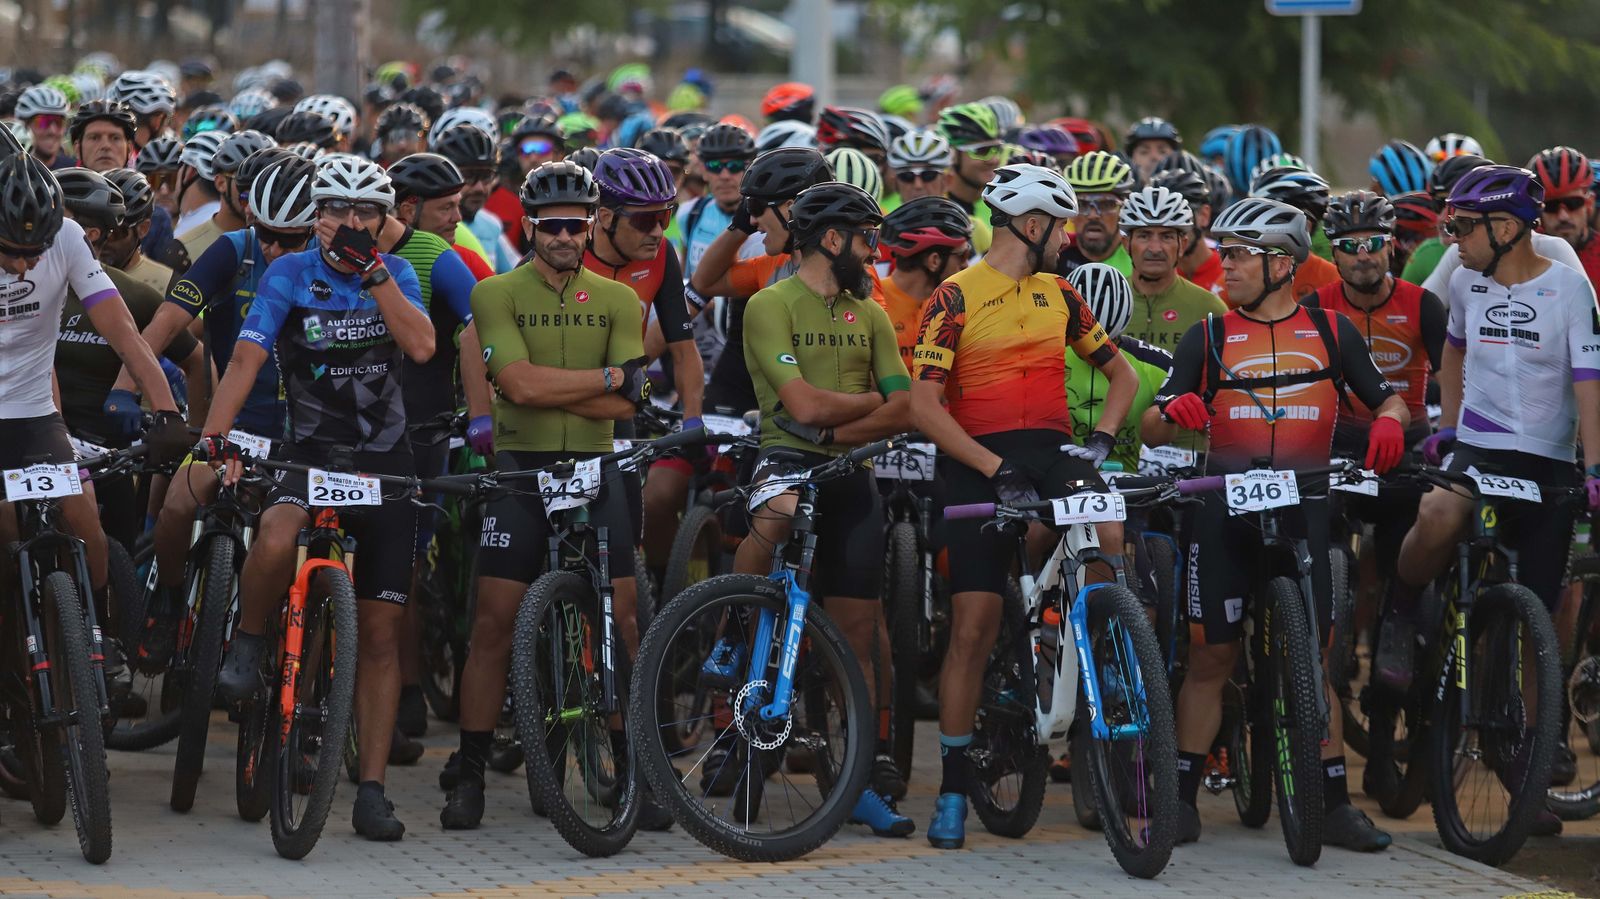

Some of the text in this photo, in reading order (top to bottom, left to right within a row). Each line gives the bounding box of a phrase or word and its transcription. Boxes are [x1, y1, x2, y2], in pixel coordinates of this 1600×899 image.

[1480, 192, 1514, 203] SCOTT
[518, 314, 607, 327] SURBIKES
[1492, 310, 1530, 319] SYMISUR
[335, 323, 390, 340] CEDRO
[925, 352, 943, 361] FAN
[330, 363, 388, 376] EDIFICARTE
[21, 476, 54, 492] 13
[1481, 477, 1525, 491] 434
[313, 486, 364, 502] 280
[1232, 483, 1282, 506] 346
[1058, 495, 1108, 515] 173
[1190, 543, 1202, 618] SYMISUR
